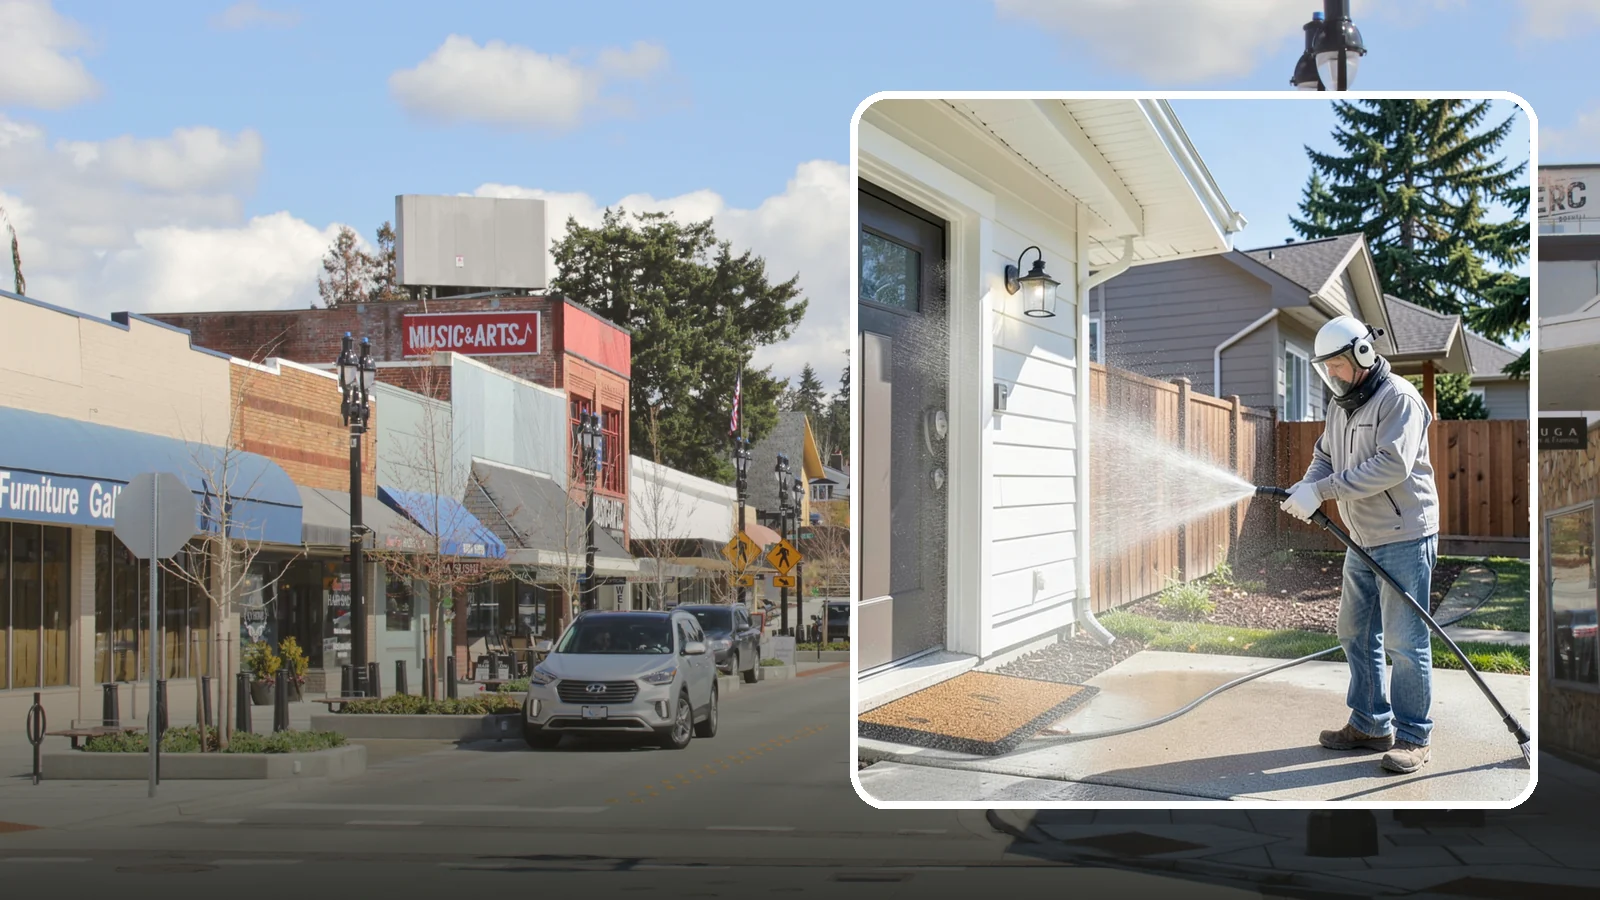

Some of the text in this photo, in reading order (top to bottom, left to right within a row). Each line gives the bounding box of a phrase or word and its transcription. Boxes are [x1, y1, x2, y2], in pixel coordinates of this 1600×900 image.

[409, 323, 519, 349] MUSIC&ARTS
[1540, 427, 1578, 436] UGA
[0, 471, 122, 519] Furniture Gal
